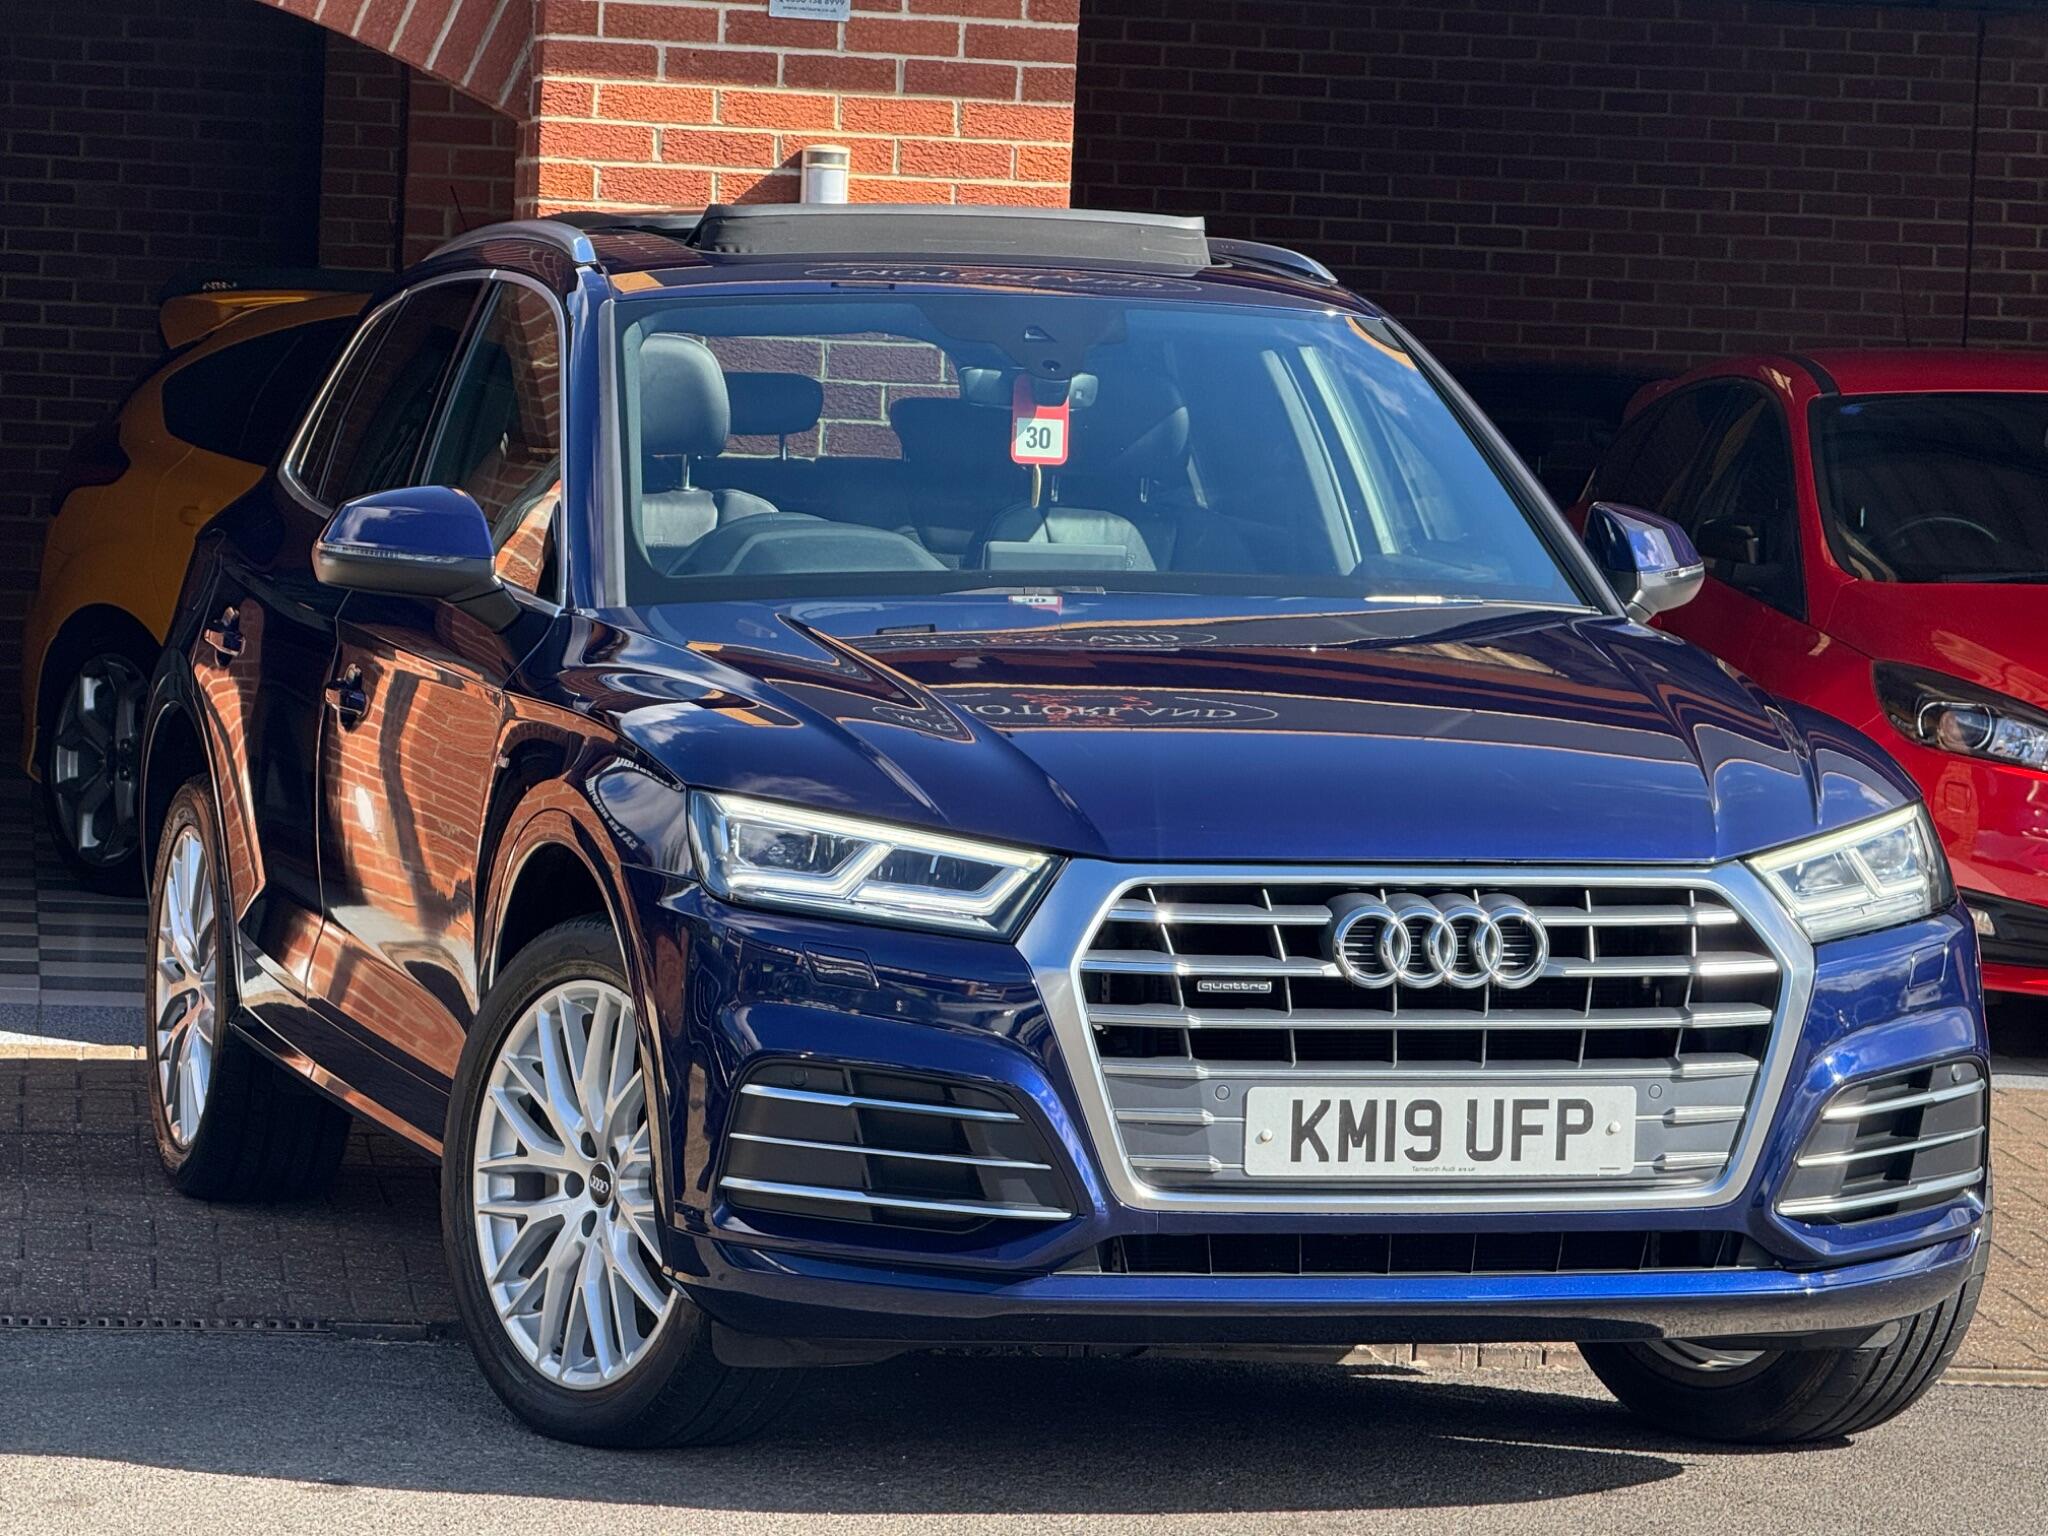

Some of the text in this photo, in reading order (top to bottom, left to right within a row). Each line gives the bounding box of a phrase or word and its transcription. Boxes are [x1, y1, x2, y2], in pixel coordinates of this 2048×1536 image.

[1025, 426, 1051, 450] 30
[1201, 982, 1269, 991] quattro
[1291, 1099, 1594, 1162] KM19 UFP
